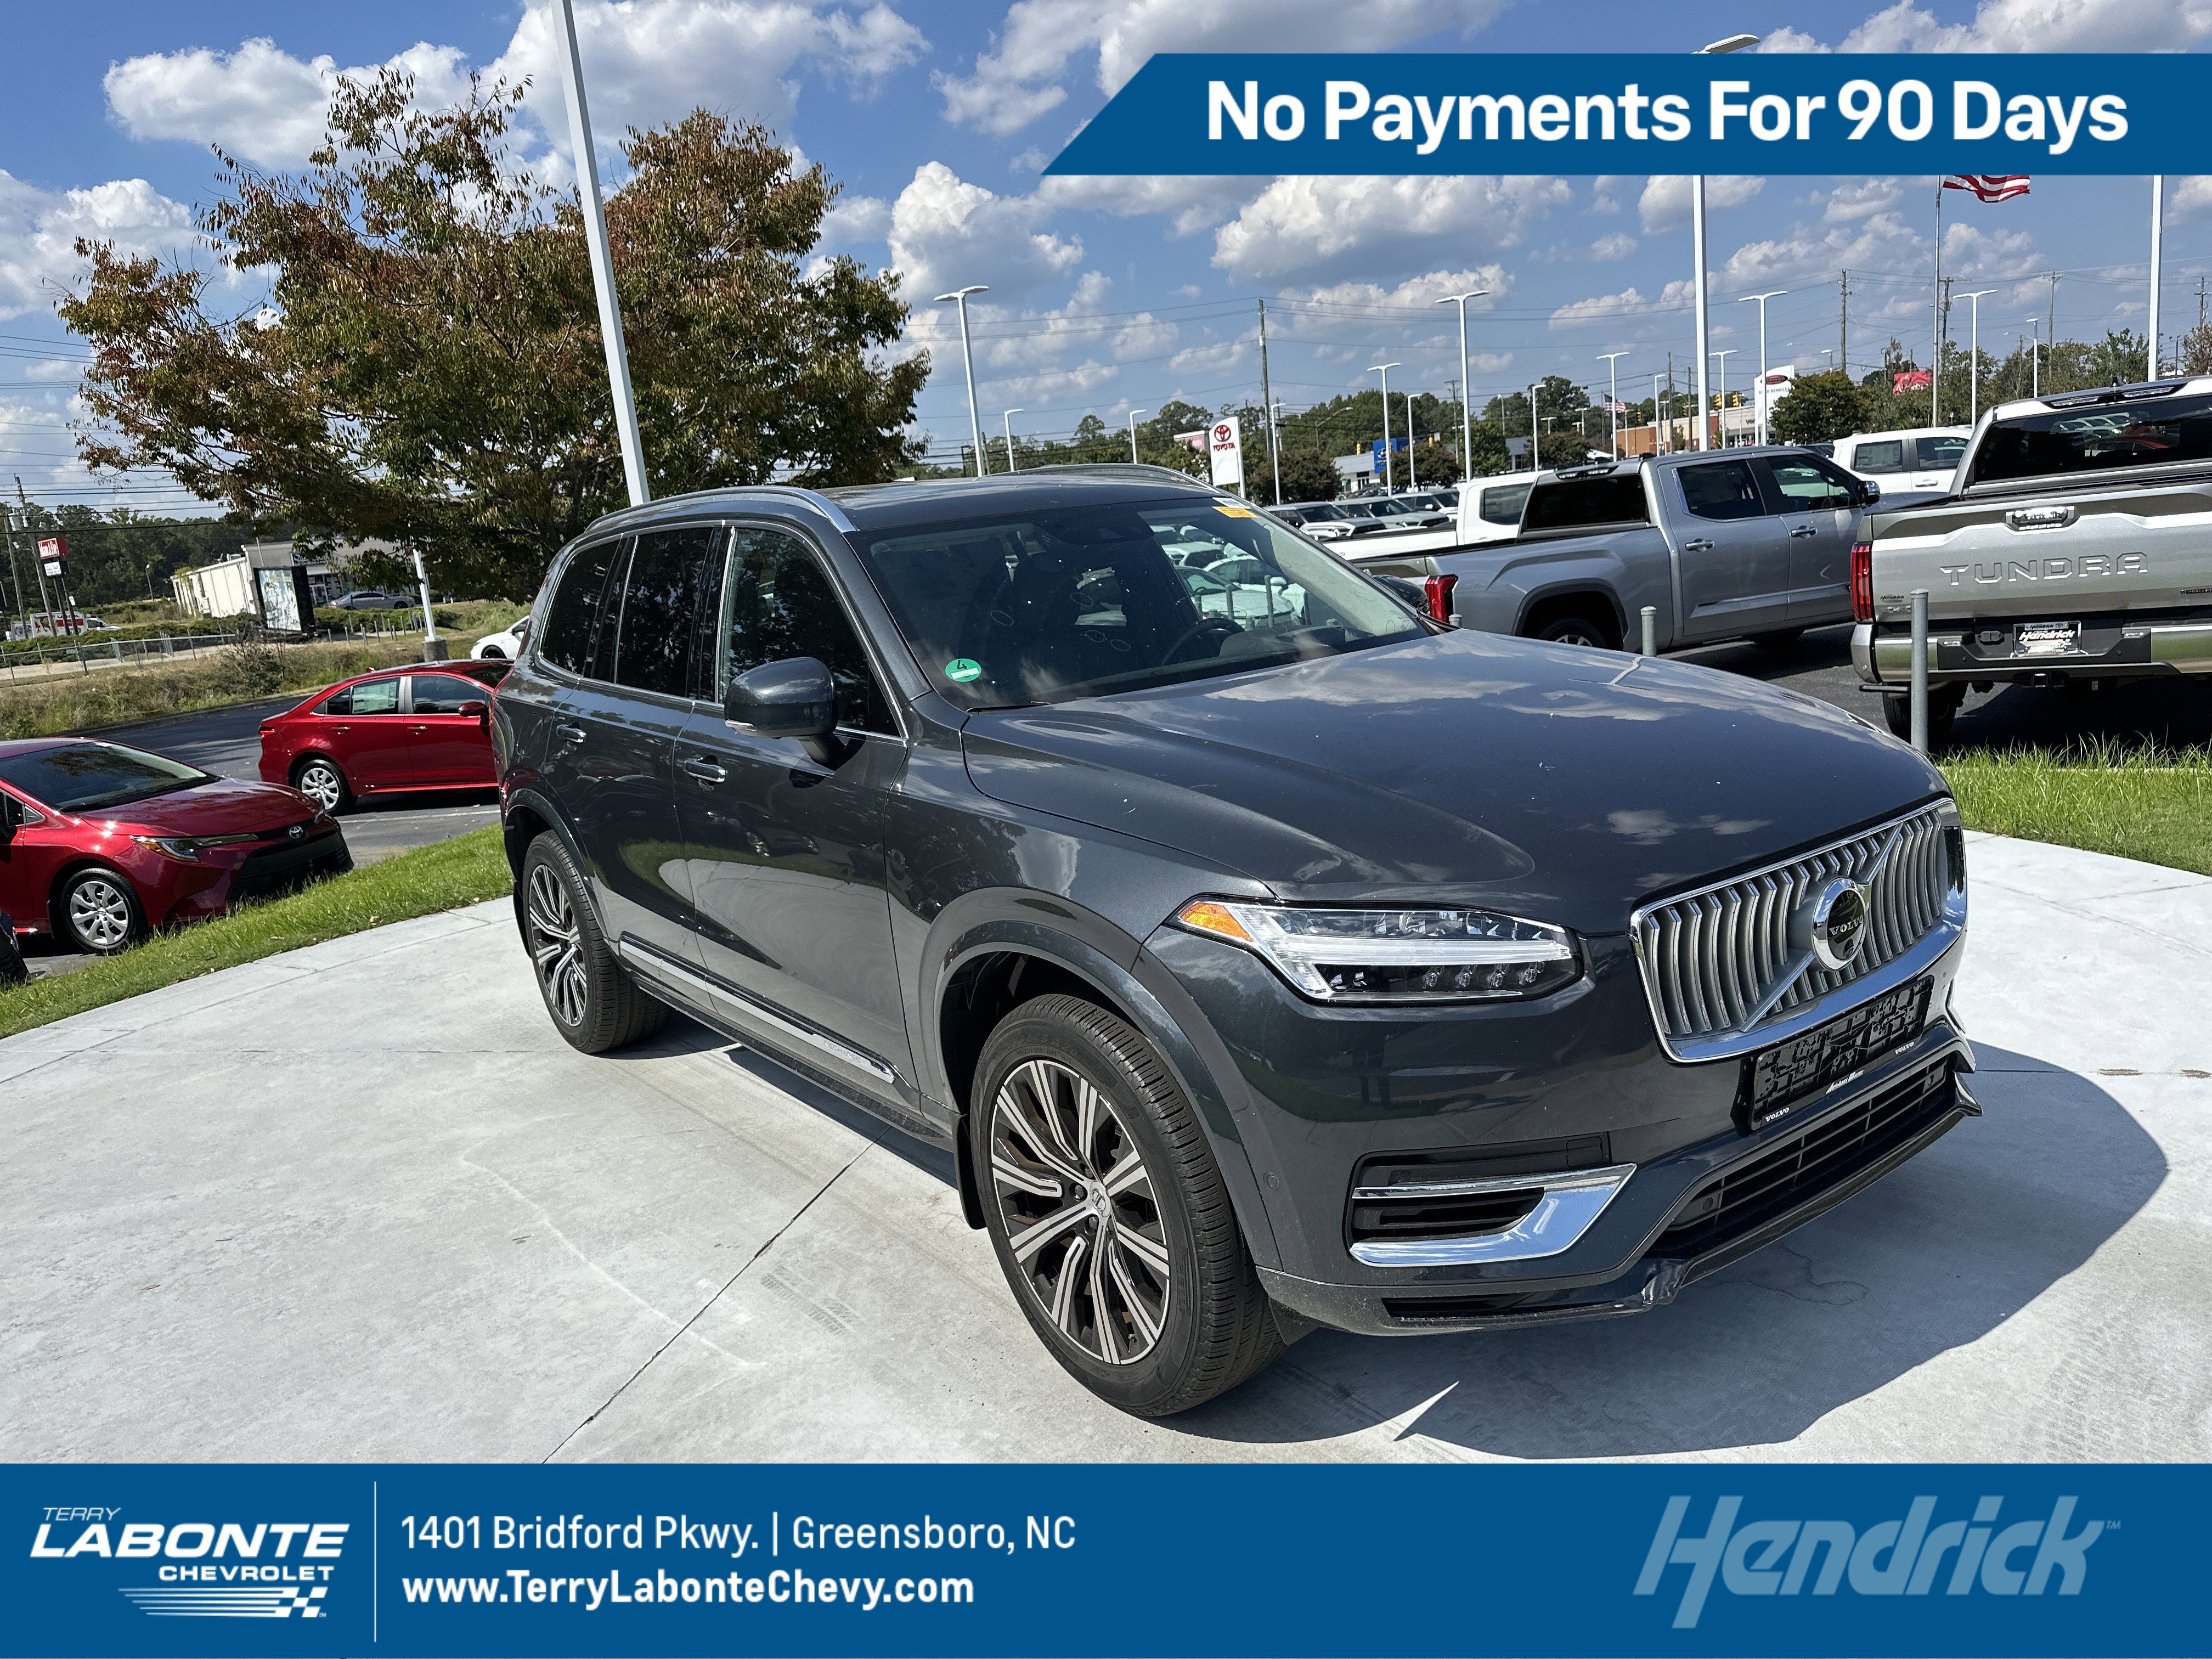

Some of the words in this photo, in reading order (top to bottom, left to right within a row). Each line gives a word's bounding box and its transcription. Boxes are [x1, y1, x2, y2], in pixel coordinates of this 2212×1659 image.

[1212, 442, 1236, 452] TOYOTA
[1940, 552, 2148, 586] TUNDRA
[957, 659, 968, 670] 4
[1829, 913, 1864, 936] VOLVO
[1895, 1041, 1915, 1054] VOLVO
[1765, 1107, 1790, 1122] VOLVO
